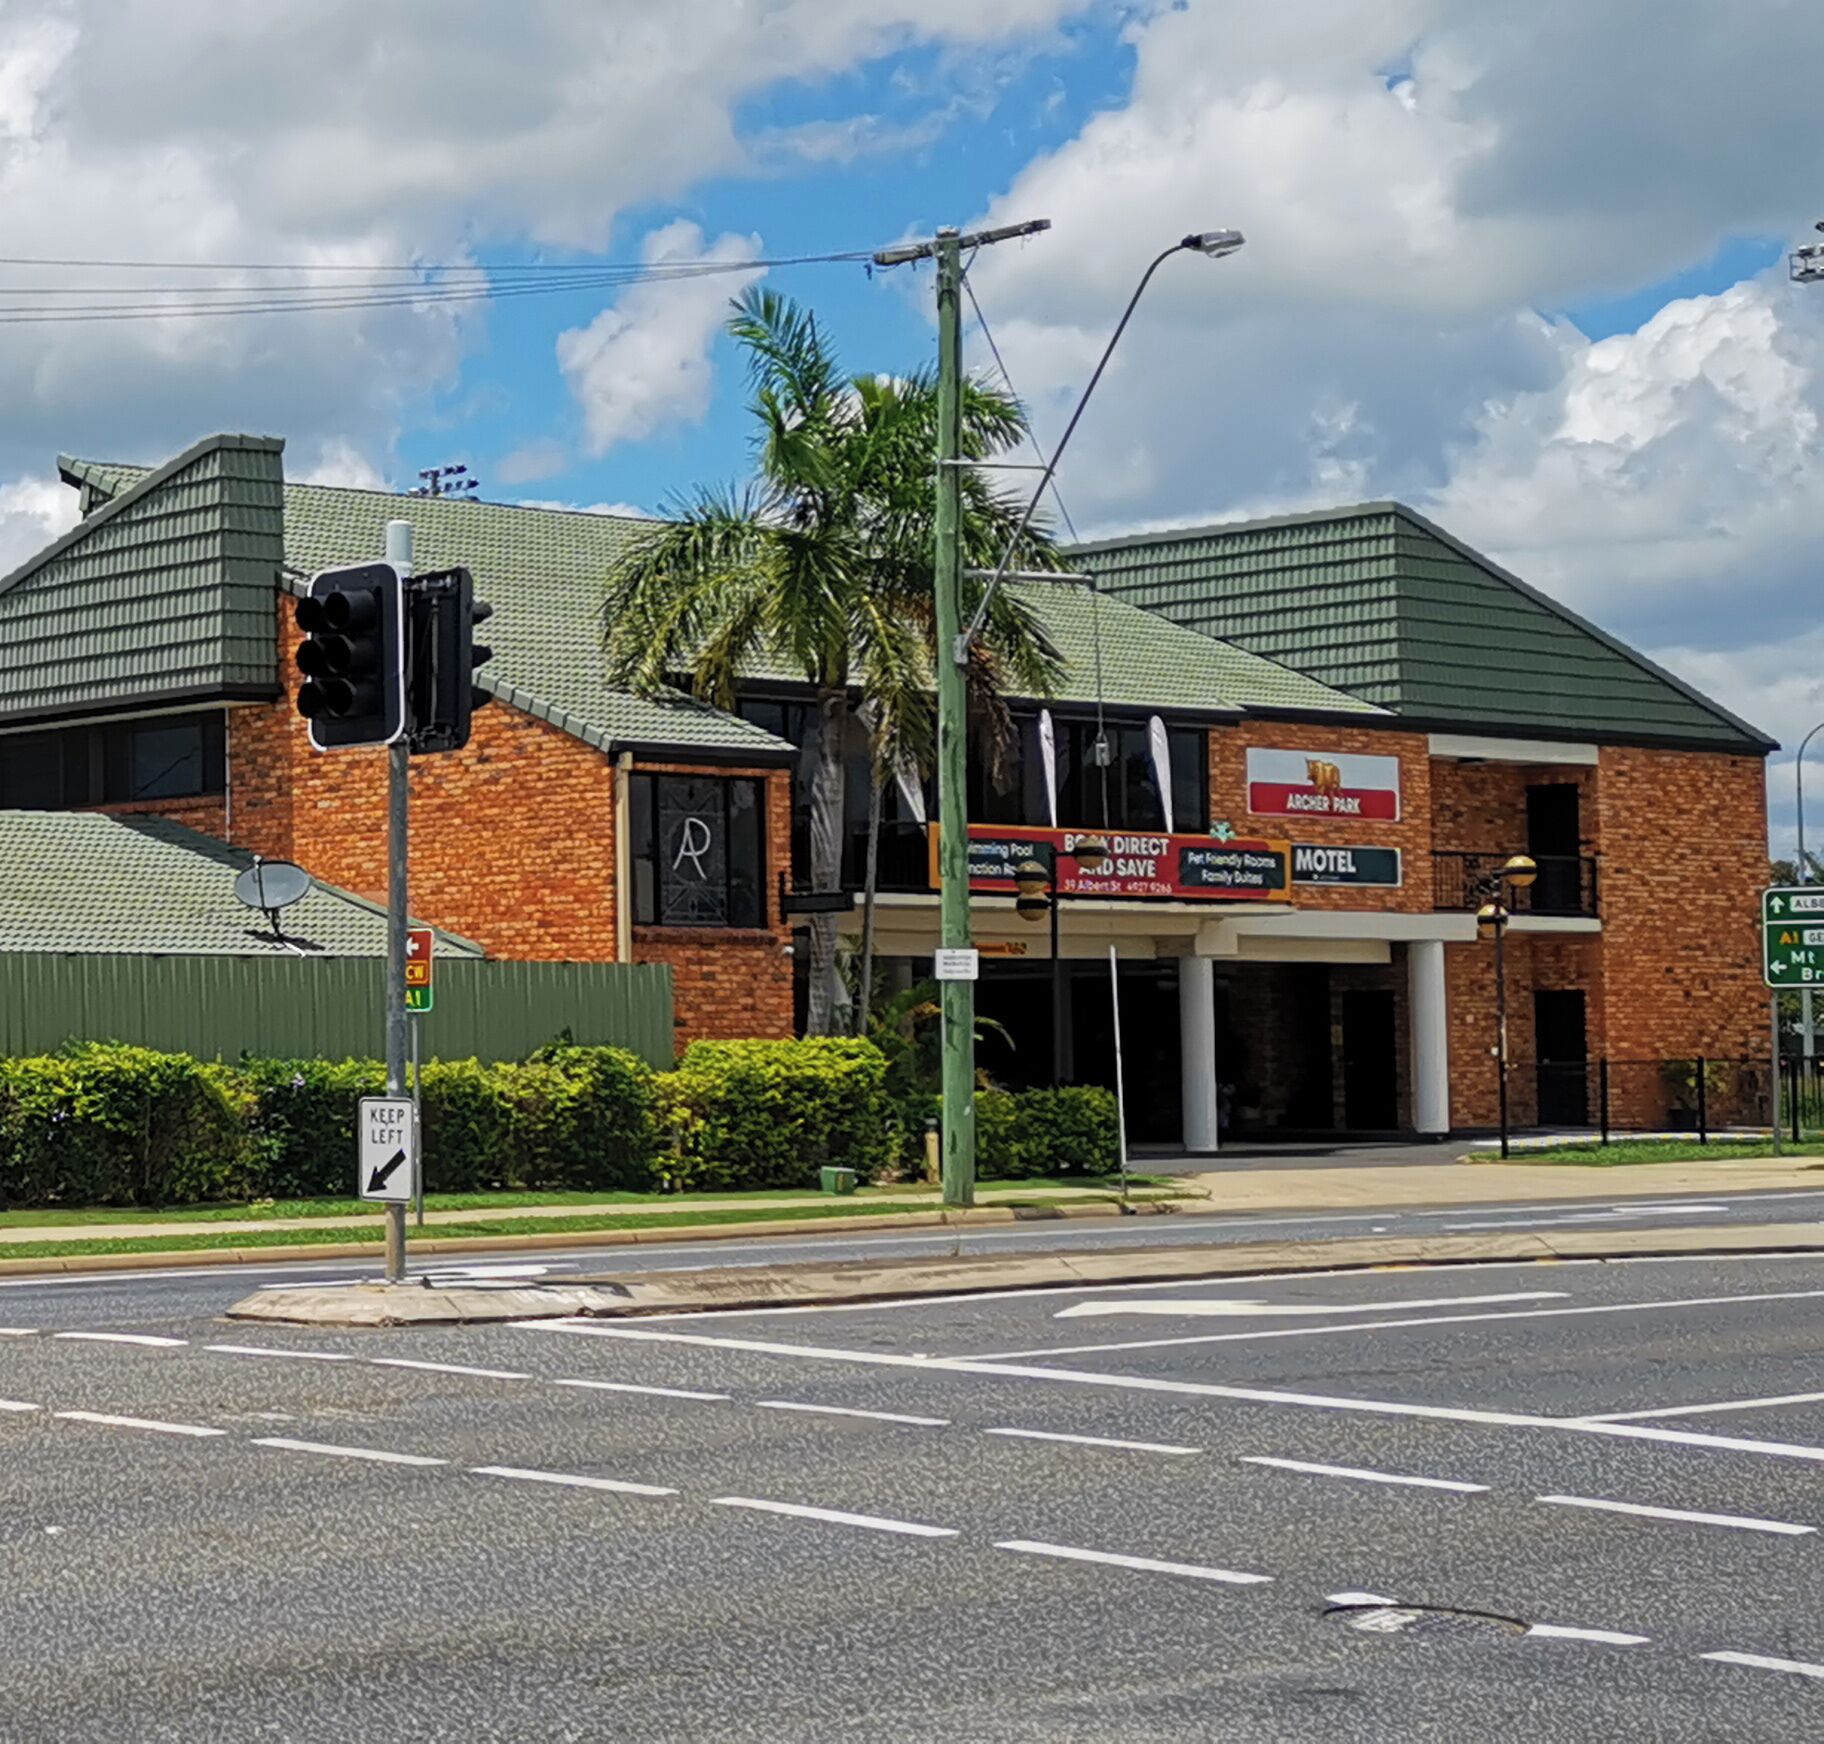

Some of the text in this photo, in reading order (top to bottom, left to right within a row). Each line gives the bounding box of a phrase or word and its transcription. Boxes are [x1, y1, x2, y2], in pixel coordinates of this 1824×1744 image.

[1286, 793, 1361, 814] ARCHER PARK
[1010, 843, 1034, 856] Pool
[1064, 834, 1169, 856] BK DIRECT
[1117, 859, 1156, 877] SAVE
[1188, 852, 1275, 868] Pet Friendly Rooms
[1295, 849, 1356, 873] MOTEL
[1202, 869, 1232, 885] Family
[1078, 880, 1109, 892] Albert
[1779, 931, 1799, 945] A1
[1791, 950, 1816, 964] Mt
[370, 1108, 405, 1124] KEEP
[371, 1129, 403, 1144] LEFT
